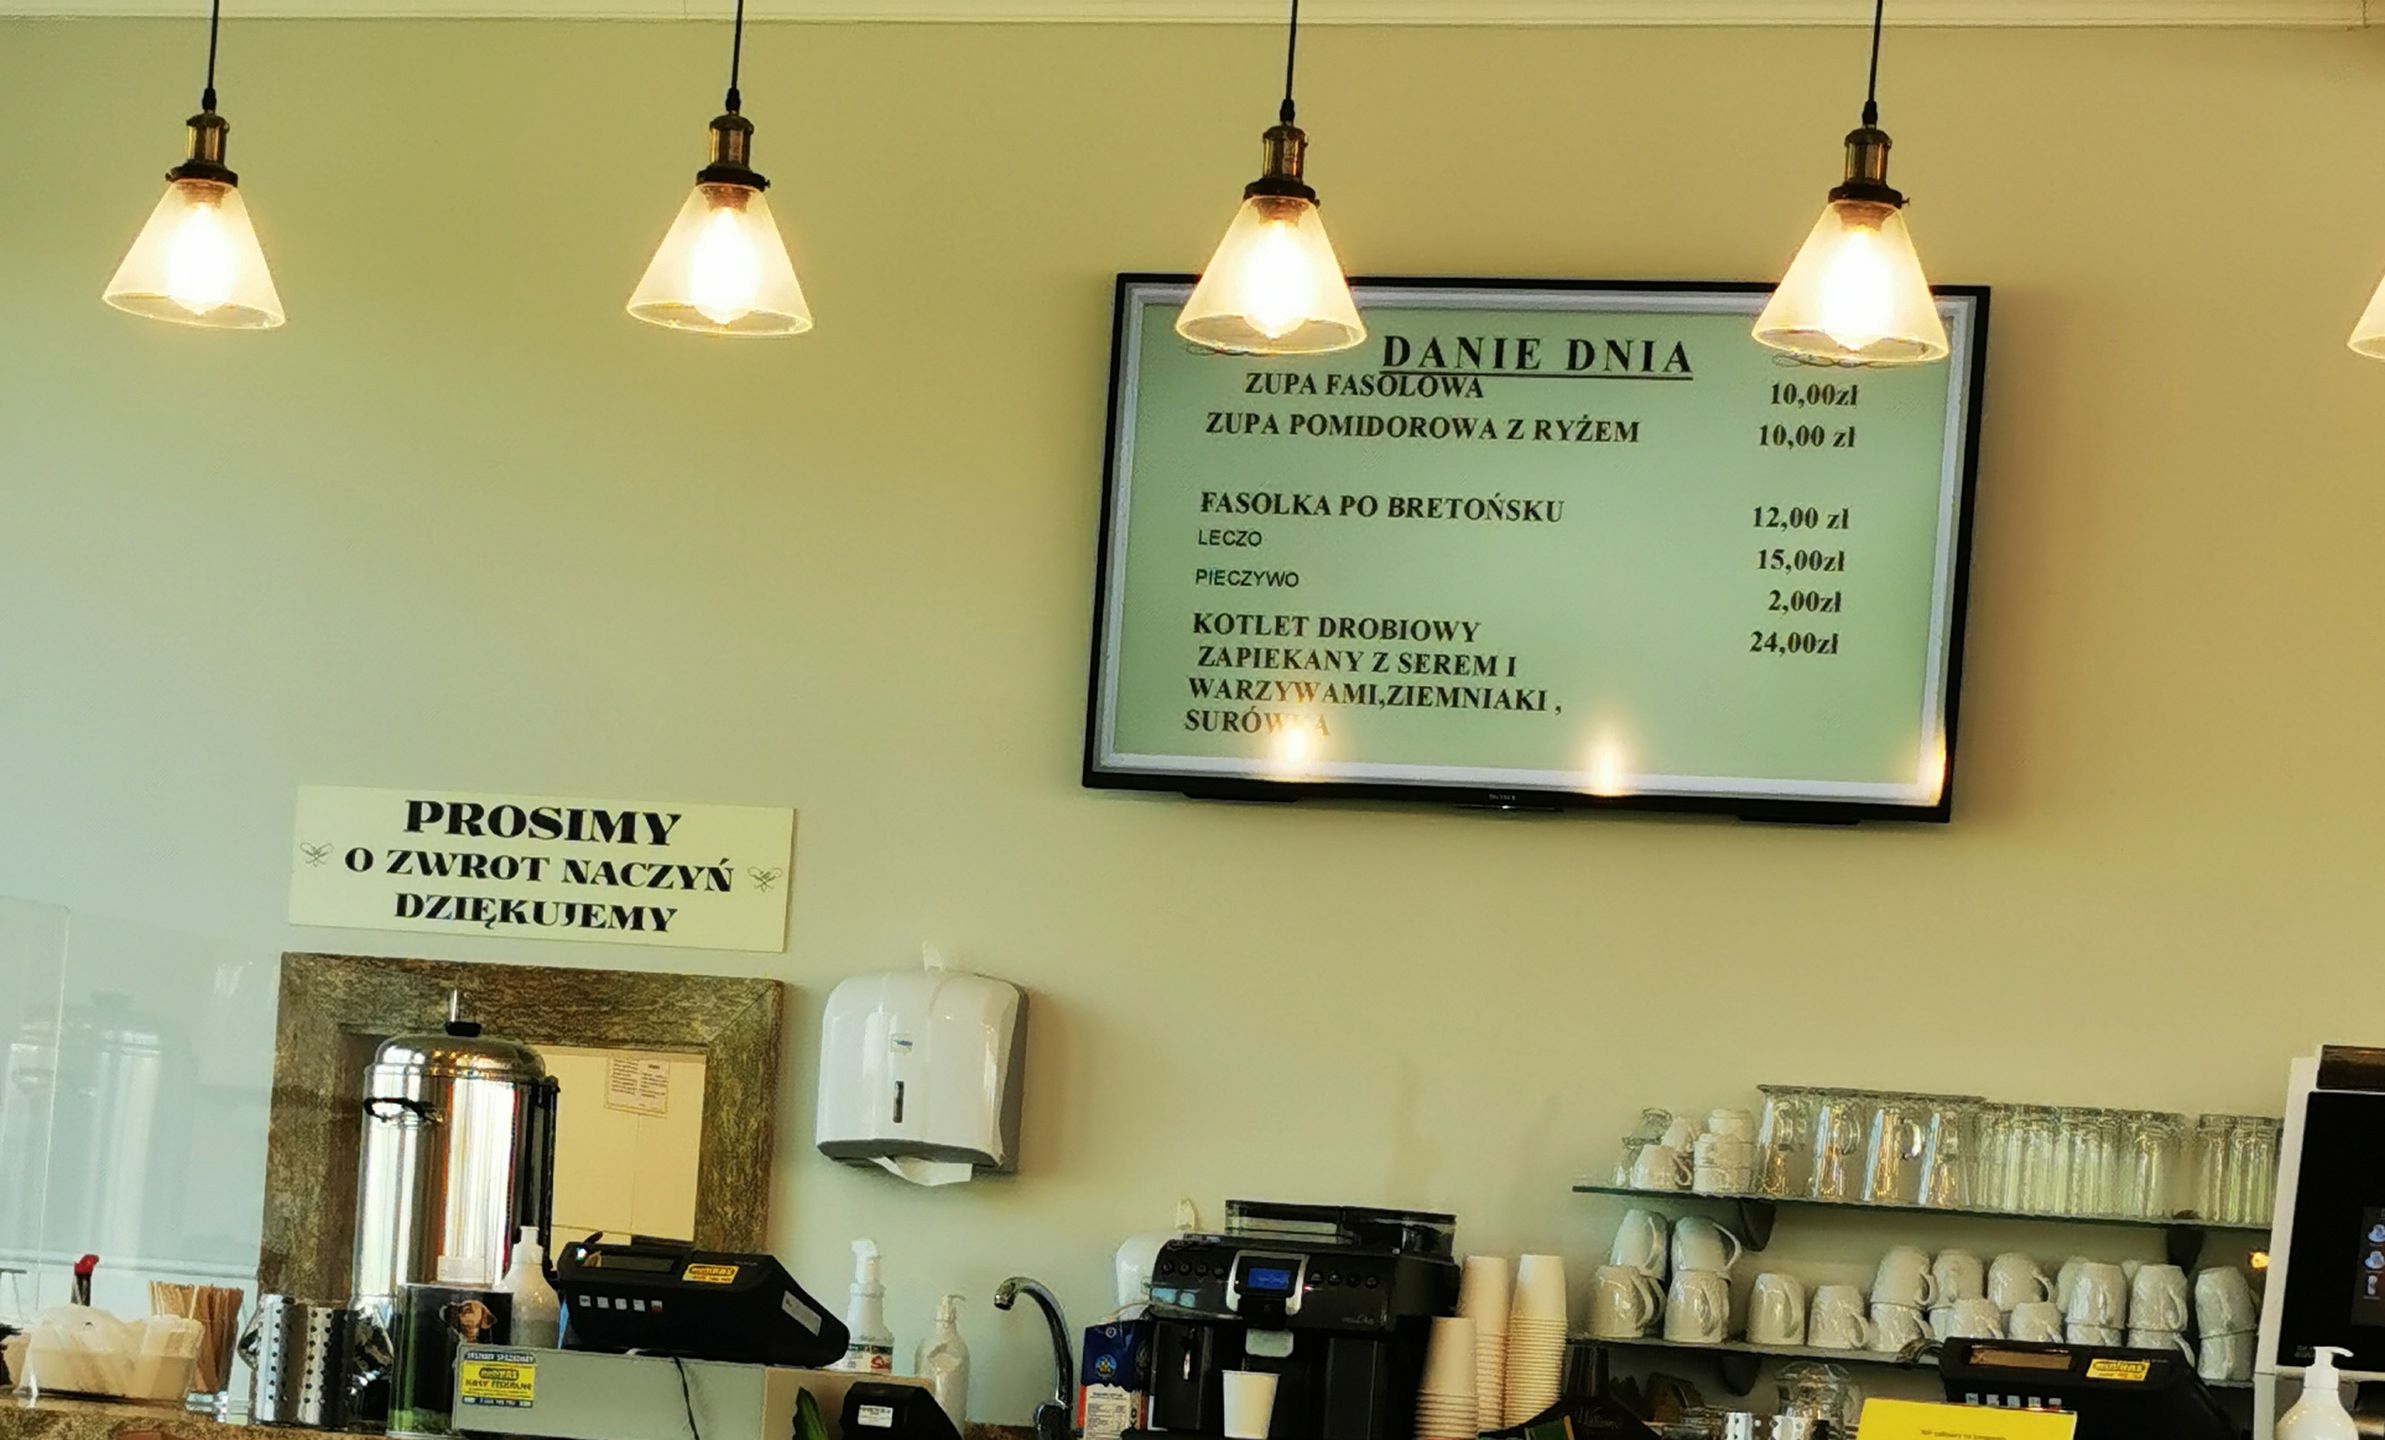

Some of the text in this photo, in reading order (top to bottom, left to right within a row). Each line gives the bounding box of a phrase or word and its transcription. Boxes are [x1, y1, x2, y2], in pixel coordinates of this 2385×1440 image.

[1382, 335, 1693, 374] DANIE DNIA
[1244, 372, 1484, 399] ZUPA FASOLOWA
[1205, 411, 1640, 443] ZUPA POMIDOROWA Z RYŻEM
[1759, 423, 1826, 450] 10,00
[1200, 491, 1565, 523] FASOLKA PO BRETOŃSKU
[1753, 505, 1849, 532] 12,00 zł
[1198, 528, 1263, 548] LECZO
[1757, 548, 1846, 576] 15,00zł
[1195, 568, 1300, 588] PIECZYWO
[1767, 589, 1842, 615] 2,00zł
[1192, 612, 1482, 643] KOTLET DROBIOWY
[1749, 630, 1839, 656] 24,00zł
[1197, 645, 1517, 678] ZAPIEKANY Z SEREM I
[1188, 677, 1548, 712] WARZYWAMI,ZIEMNIAKI
[1183, 705, 1330, 737] SURÓWA
[402, 799, 683, 847] PROSIMY
[344, 846, 735, 893] O ZWROT NACZYŃ
[393, 892, 679, 933] DZIĘKUJEMY
